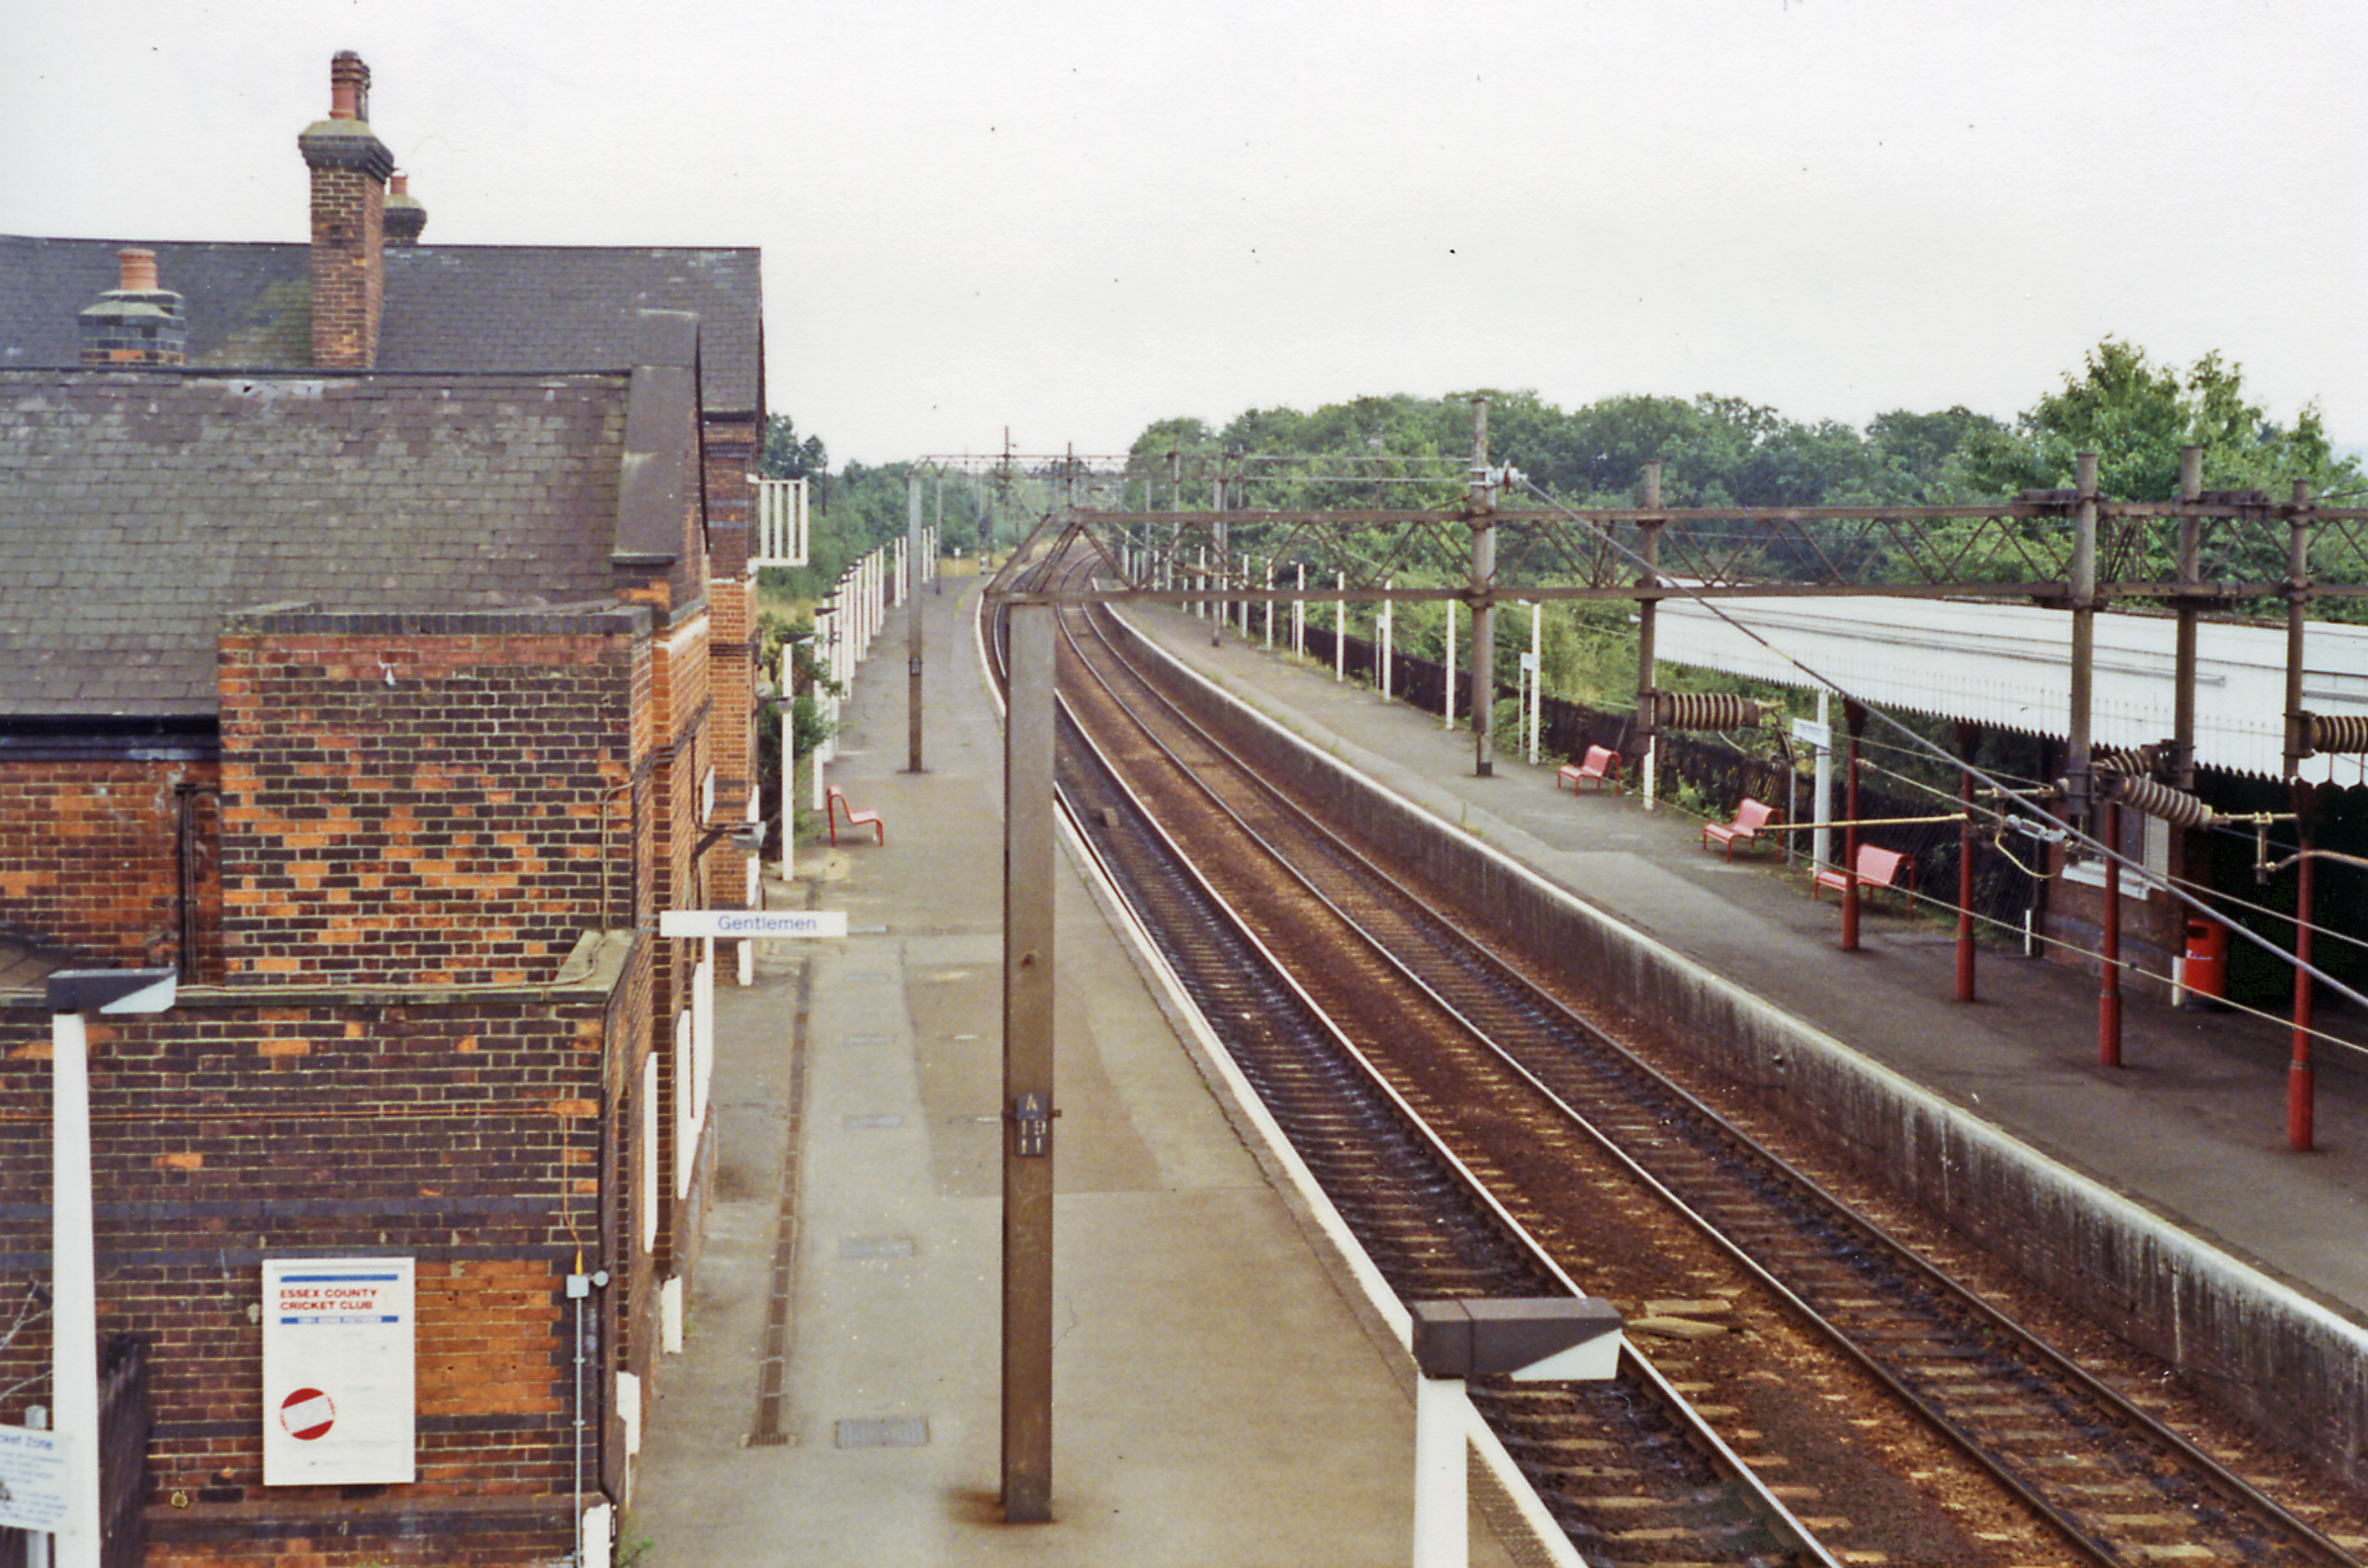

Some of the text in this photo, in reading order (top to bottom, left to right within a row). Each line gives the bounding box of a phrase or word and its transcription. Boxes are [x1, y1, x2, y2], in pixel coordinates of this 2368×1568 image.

[718, 915, 818, 930] Gentlemen
[1025, 1093, 1038, 1110] A
[280, 1288, 378, 1298] ESSEX COUNTY
[280, 1300, 373, 1310] CRICKET CLUB
